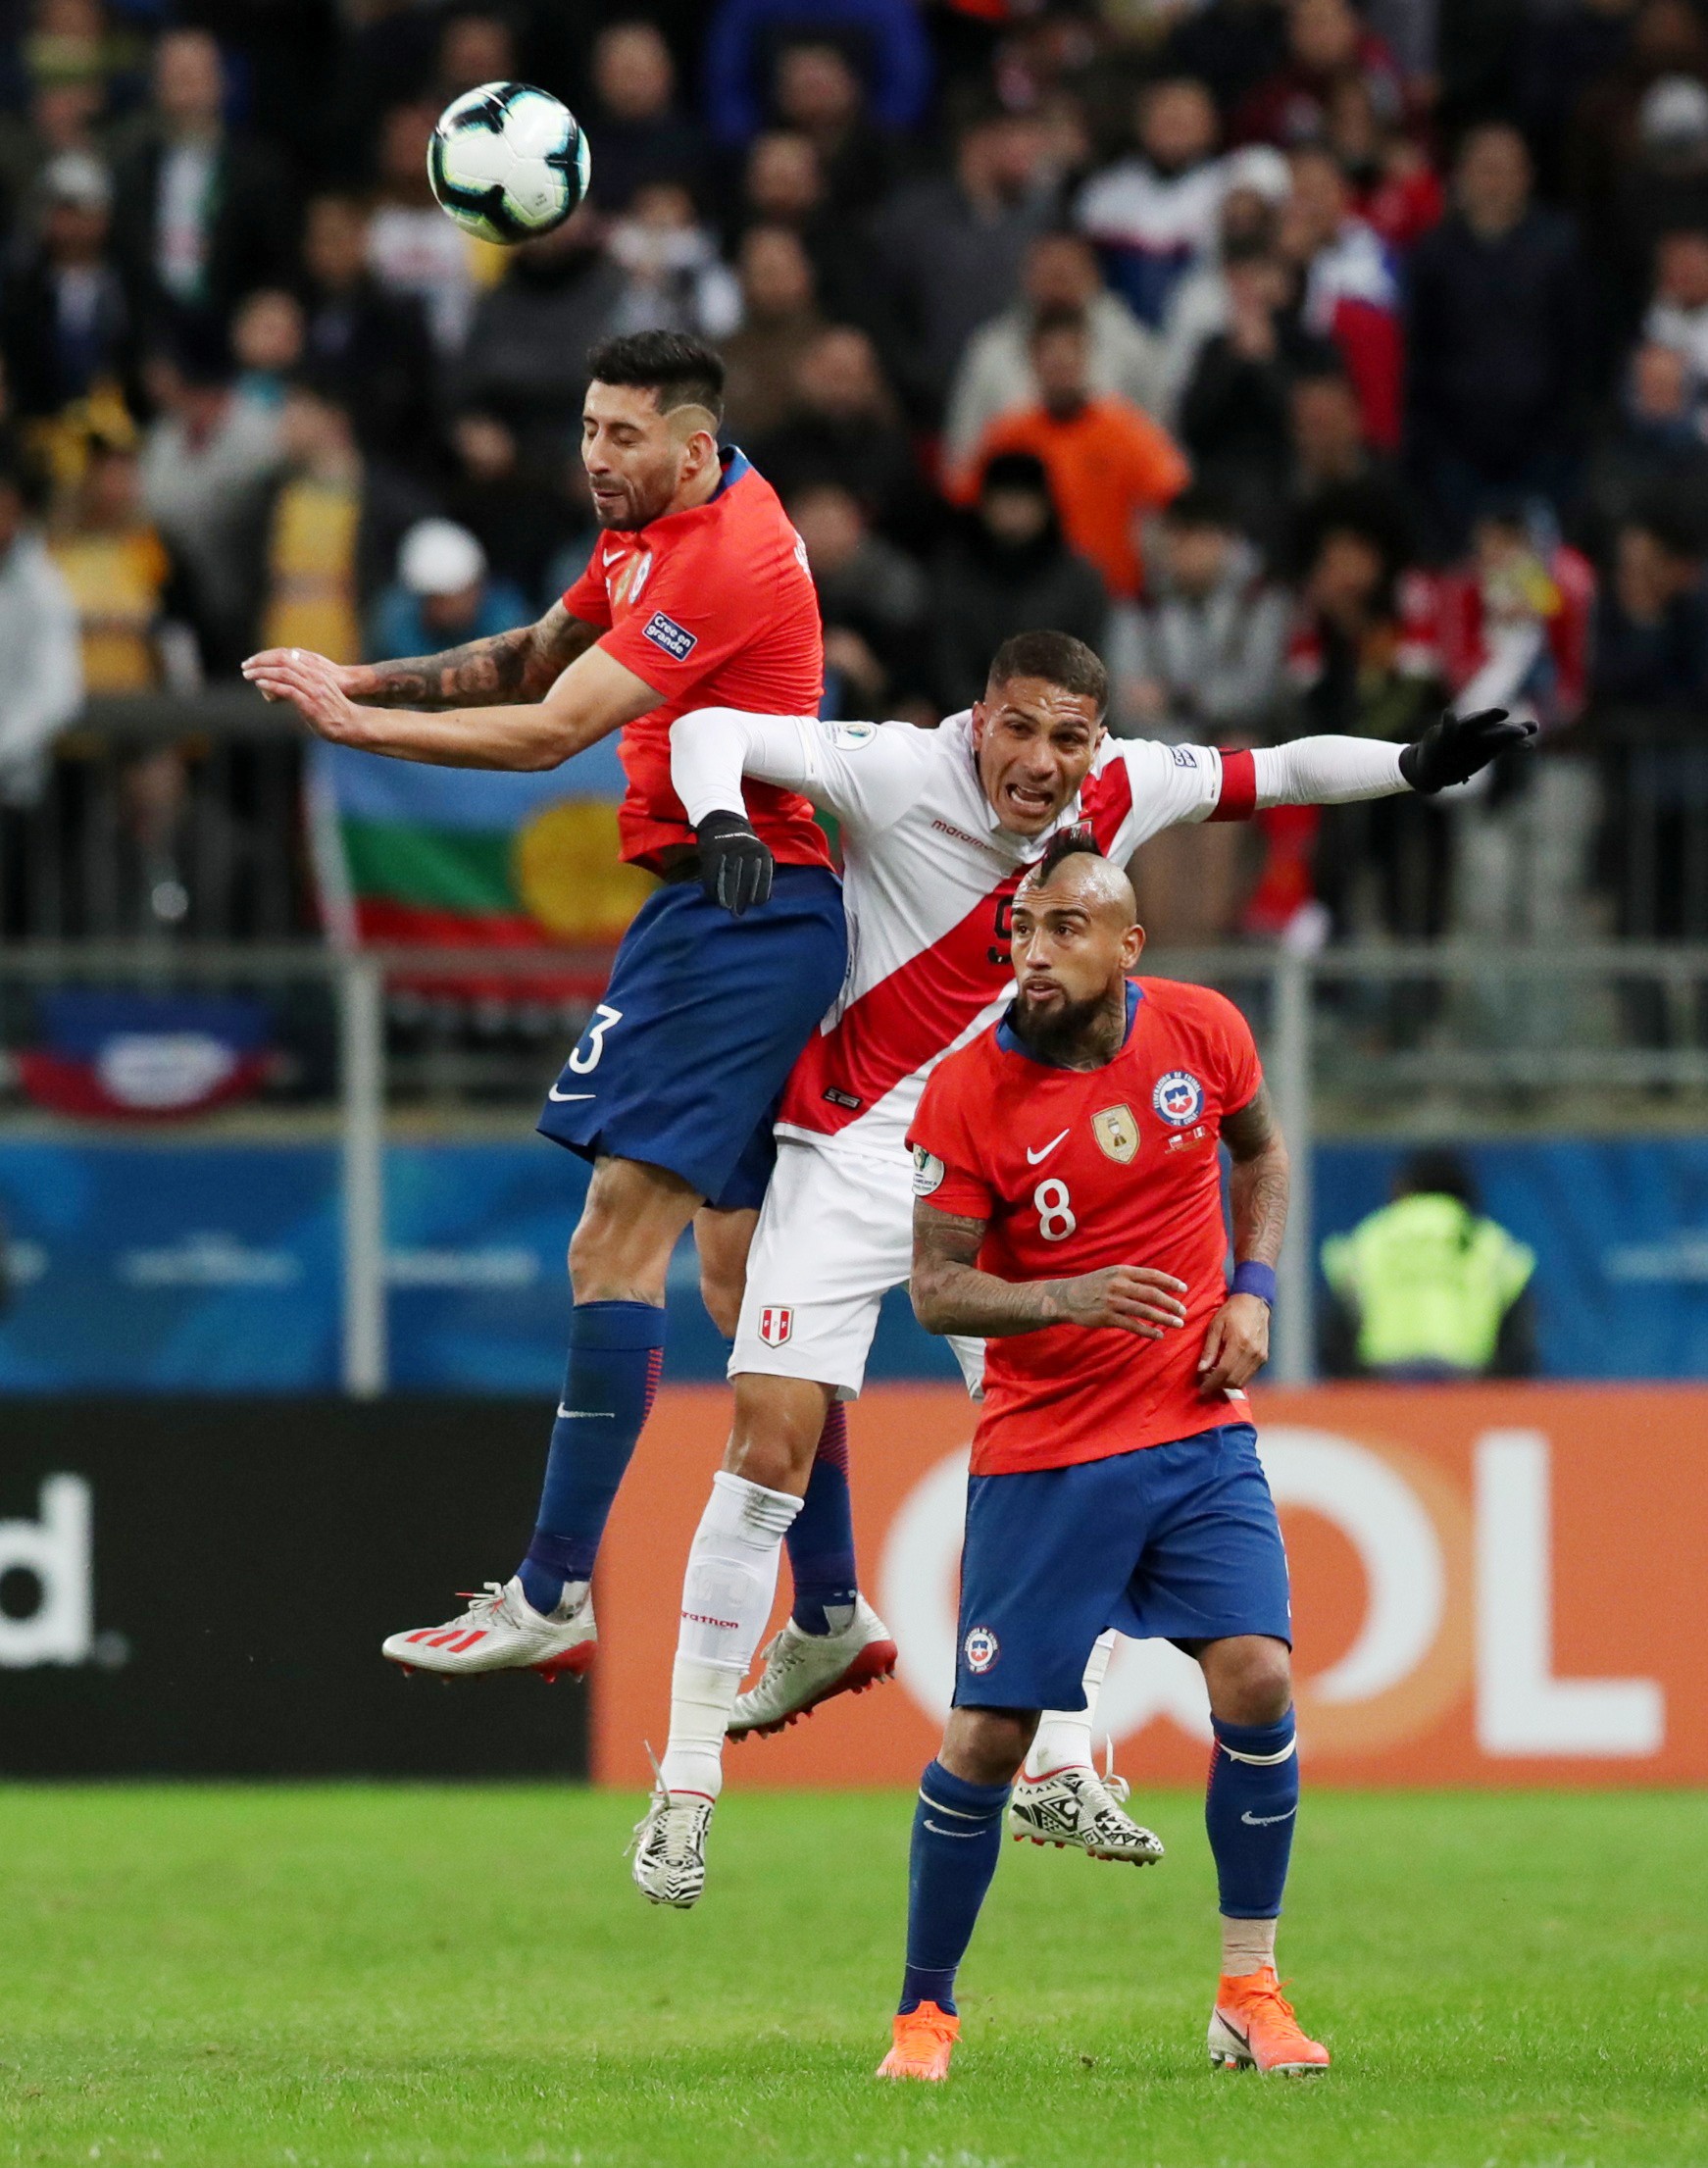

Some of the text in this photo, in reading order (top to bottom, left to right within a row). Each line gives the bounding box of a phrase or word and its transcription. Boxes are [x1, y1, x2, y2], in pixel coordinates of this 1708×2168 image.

[646, 625, 683, 654] grande
[655, 616, 691, 648] Cree en
[930, 820, 1000, 853] marath
[569, 1003, 624, 1075] 3
[1033, 1178, 1078, 1242] 8
[681, 1611, 738, 1629] rathon
